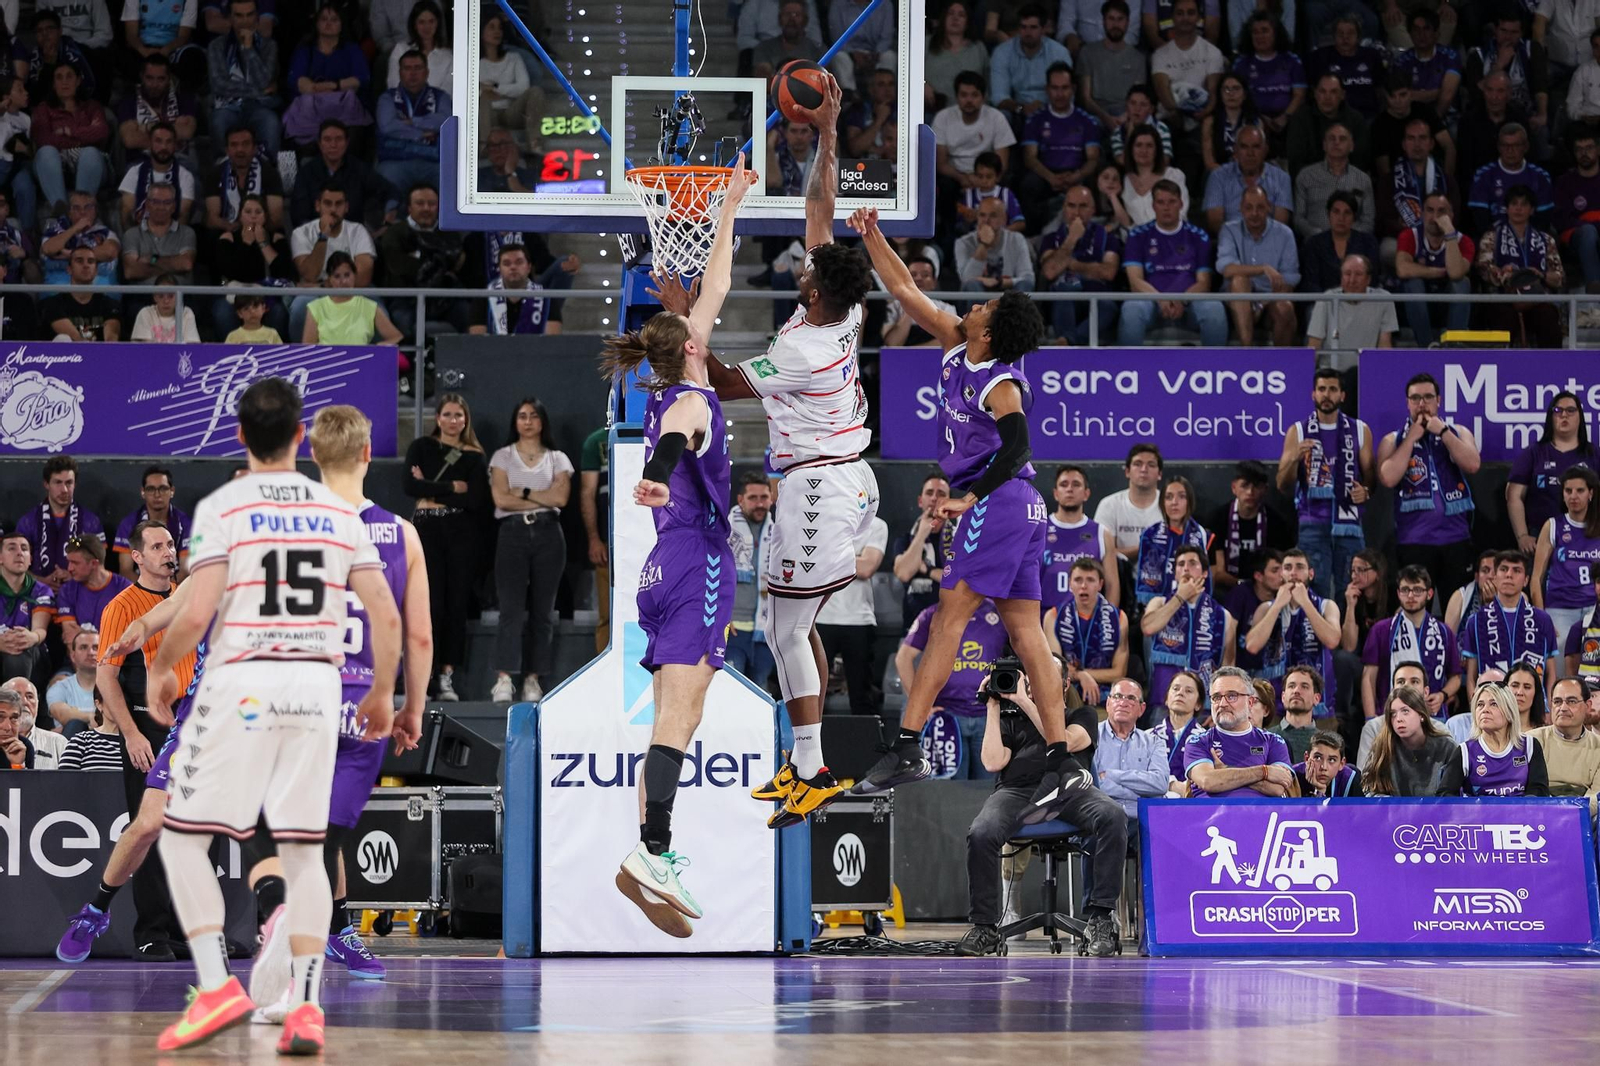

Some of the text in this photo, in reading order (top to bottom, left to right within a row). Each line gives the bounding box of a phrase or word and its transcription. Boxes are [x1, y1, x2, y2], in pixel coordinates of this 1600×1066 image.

[841, 169, 862, 181] liga
[841, 180, 888, 191] endesa
[1041, 370, 1287, 394] sara varas
[128, 383, 181, 403] Alimentos
[1173, 401, 1286, 436] dental
[945, 425, 955, 454] 4
[259, 484, 315, 501] COSTA
[1446, 489, 1463, 501] acb
[250, 512, 334, 534] PULEVA
[364, 522, 398, 544] URST
[259, 549, 324, 617] 15
[1579, 565, 1591, 585] 8
[1439, 852, 1549, 864] ON WHEELS
[1204, 906, 1341, 922] CRASH STOP PER
[1413, 919, 1545, 931] INFORMÁTICOS
